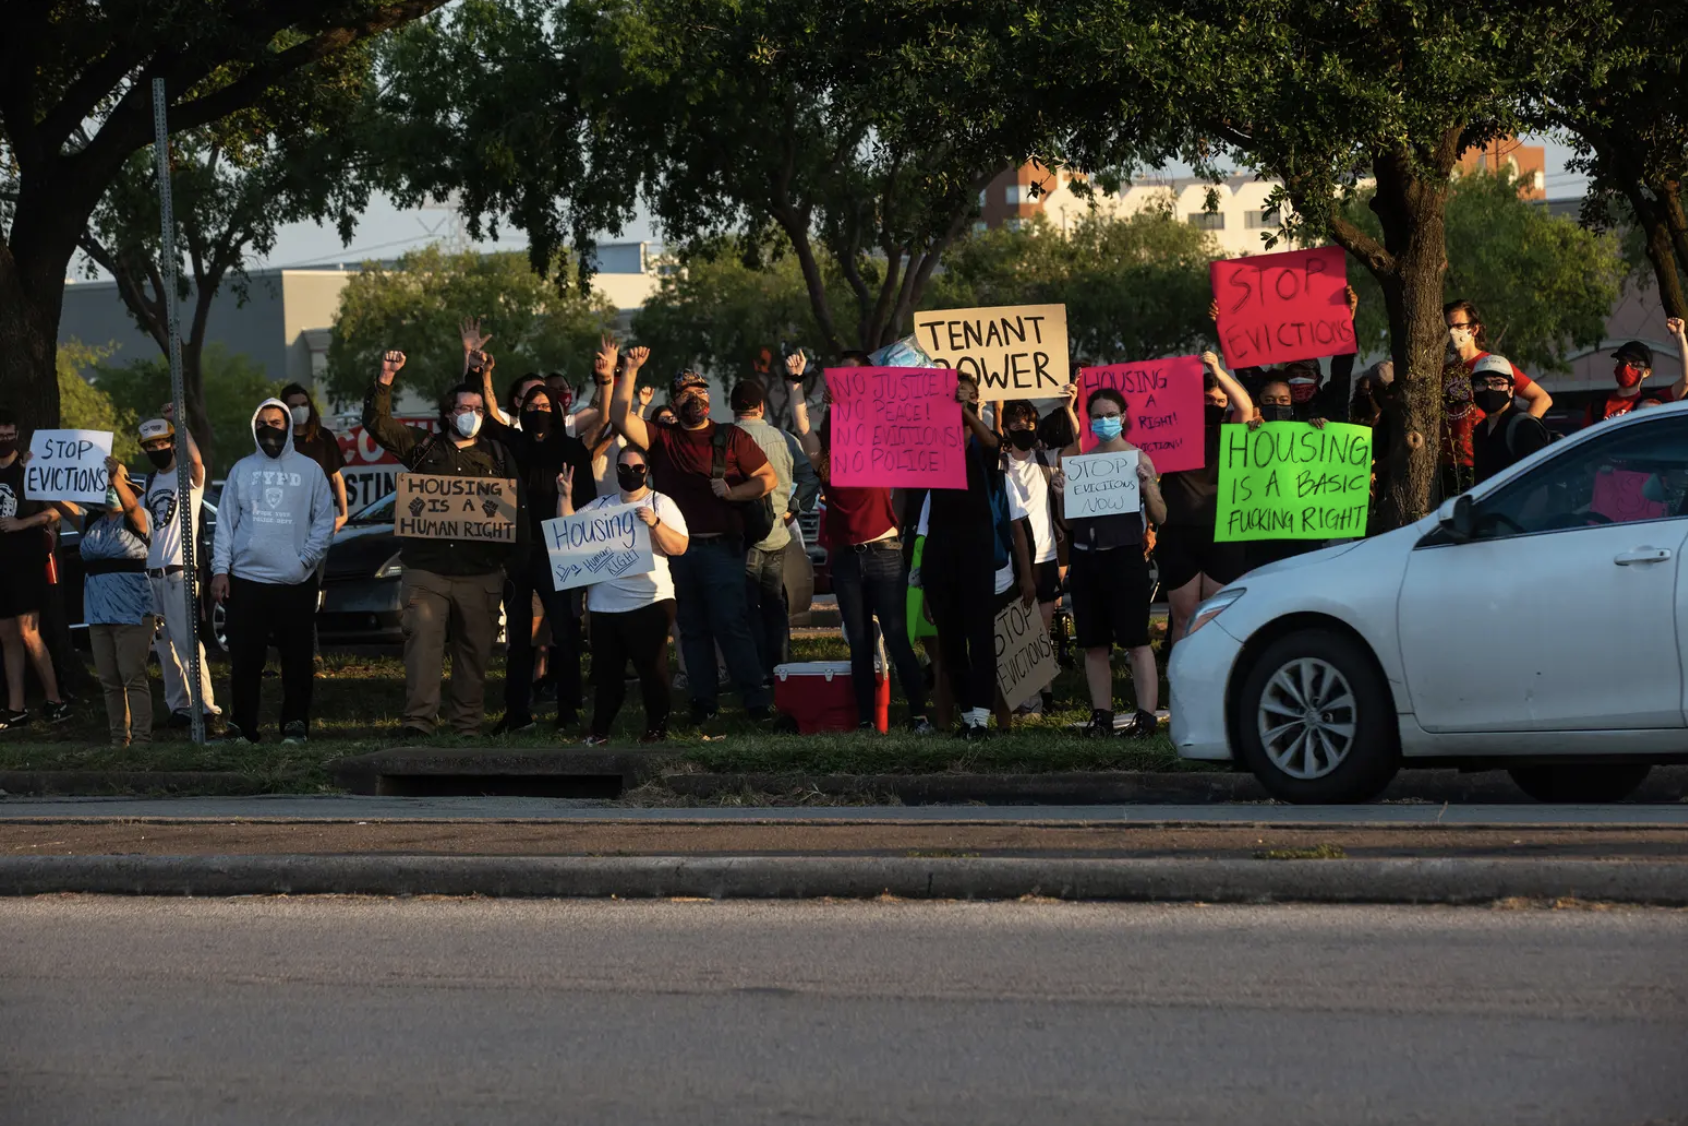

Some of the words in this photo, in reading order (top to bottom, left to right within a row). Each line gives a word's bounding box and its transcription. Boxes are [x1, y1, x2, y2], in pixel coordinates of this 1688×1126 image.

[1228, 257, 1328, 315] STOP
[919, 315, 1045, 351] TENANT
[1225, 319, 1353, 358] EVICTIONS
[833, 373, 865, 397] NO
[1084, 368, 1167, 393] HOUSING
[837, 399, 865, 422] NO
[1145, 394, 1157, 408] A
[1138, 412, 1177, 430] RIGHT!
[837, 424, 865, 446] NO
[41, 438, 94, 460] STOP
[1229, 431, 1368, 469] HOUSING
[834, 451, 864, 473] NO
[1068, 457, 1128, 481] STOP
[28, 466, 107, 492] EVICTIONS
[408, 478, 502, 496] HOUSING
[1074, 480, 1136, 495] EVICTIONS
[1232, 475, 1252, 504] IS
[1265, 469, 1280, 497] A
[1296, 470, 1365, 498] BASIC
[427, 499, 450, 512] IS
[462, 499, 475, 511] A
[1082, 496, 1124, 513] NOW
[401, 518, 458, 536] HUMAN
[463, 521, 514, 539] RIGHT
[553, 511, 636, 550] Housing
[1228, 507, 1294, 536] FUCKING
[1301, 505, 1366, 532] RIGHT
[605, 549, 640, 577] RIGHT
[996, 631, 1051, 695] EVICTIONS
